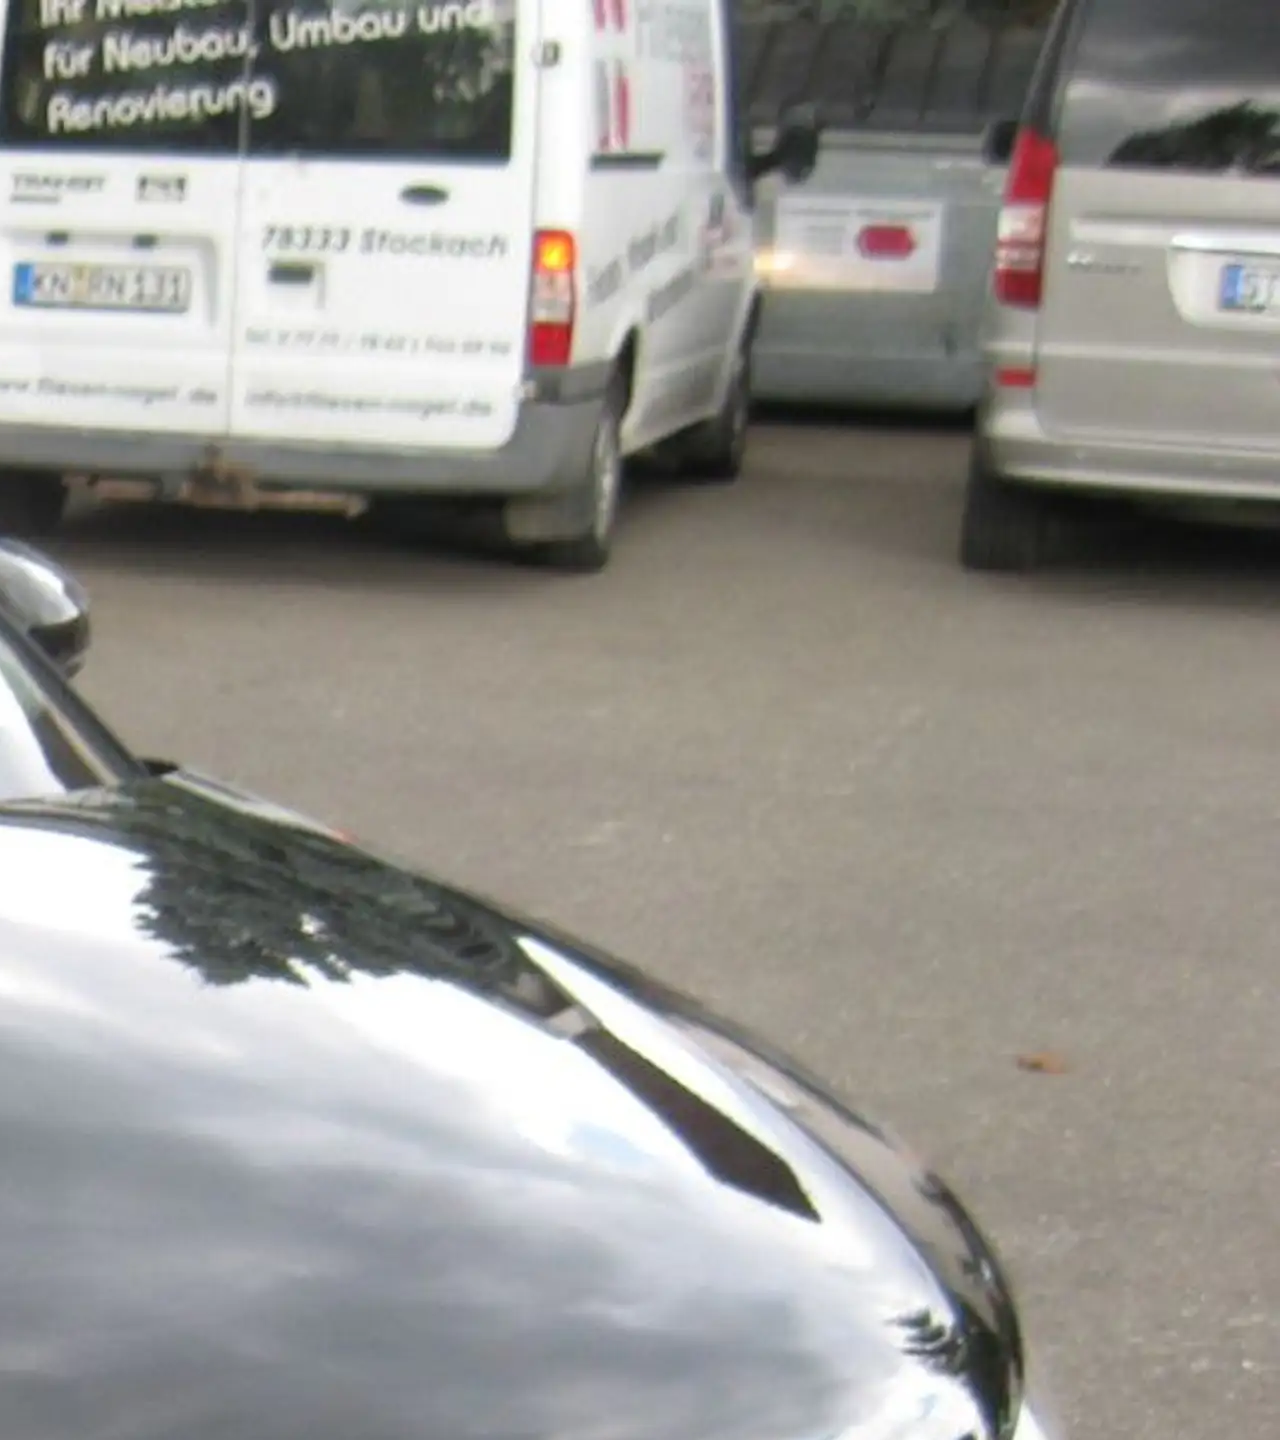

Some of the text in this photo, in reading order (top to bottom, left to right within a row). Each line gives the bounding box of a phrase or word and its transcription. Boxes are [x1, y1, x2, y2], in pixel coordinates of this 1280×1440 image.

[43, 39, 92, 79] für
[101, 24, 260, 72] Neubau,
[269, 8, 406, 50] Umbau
[417, 0, 494, 33] und
[46, 78, 276, 133] Renovierung
[359, 228, 508, 258] Stockach
